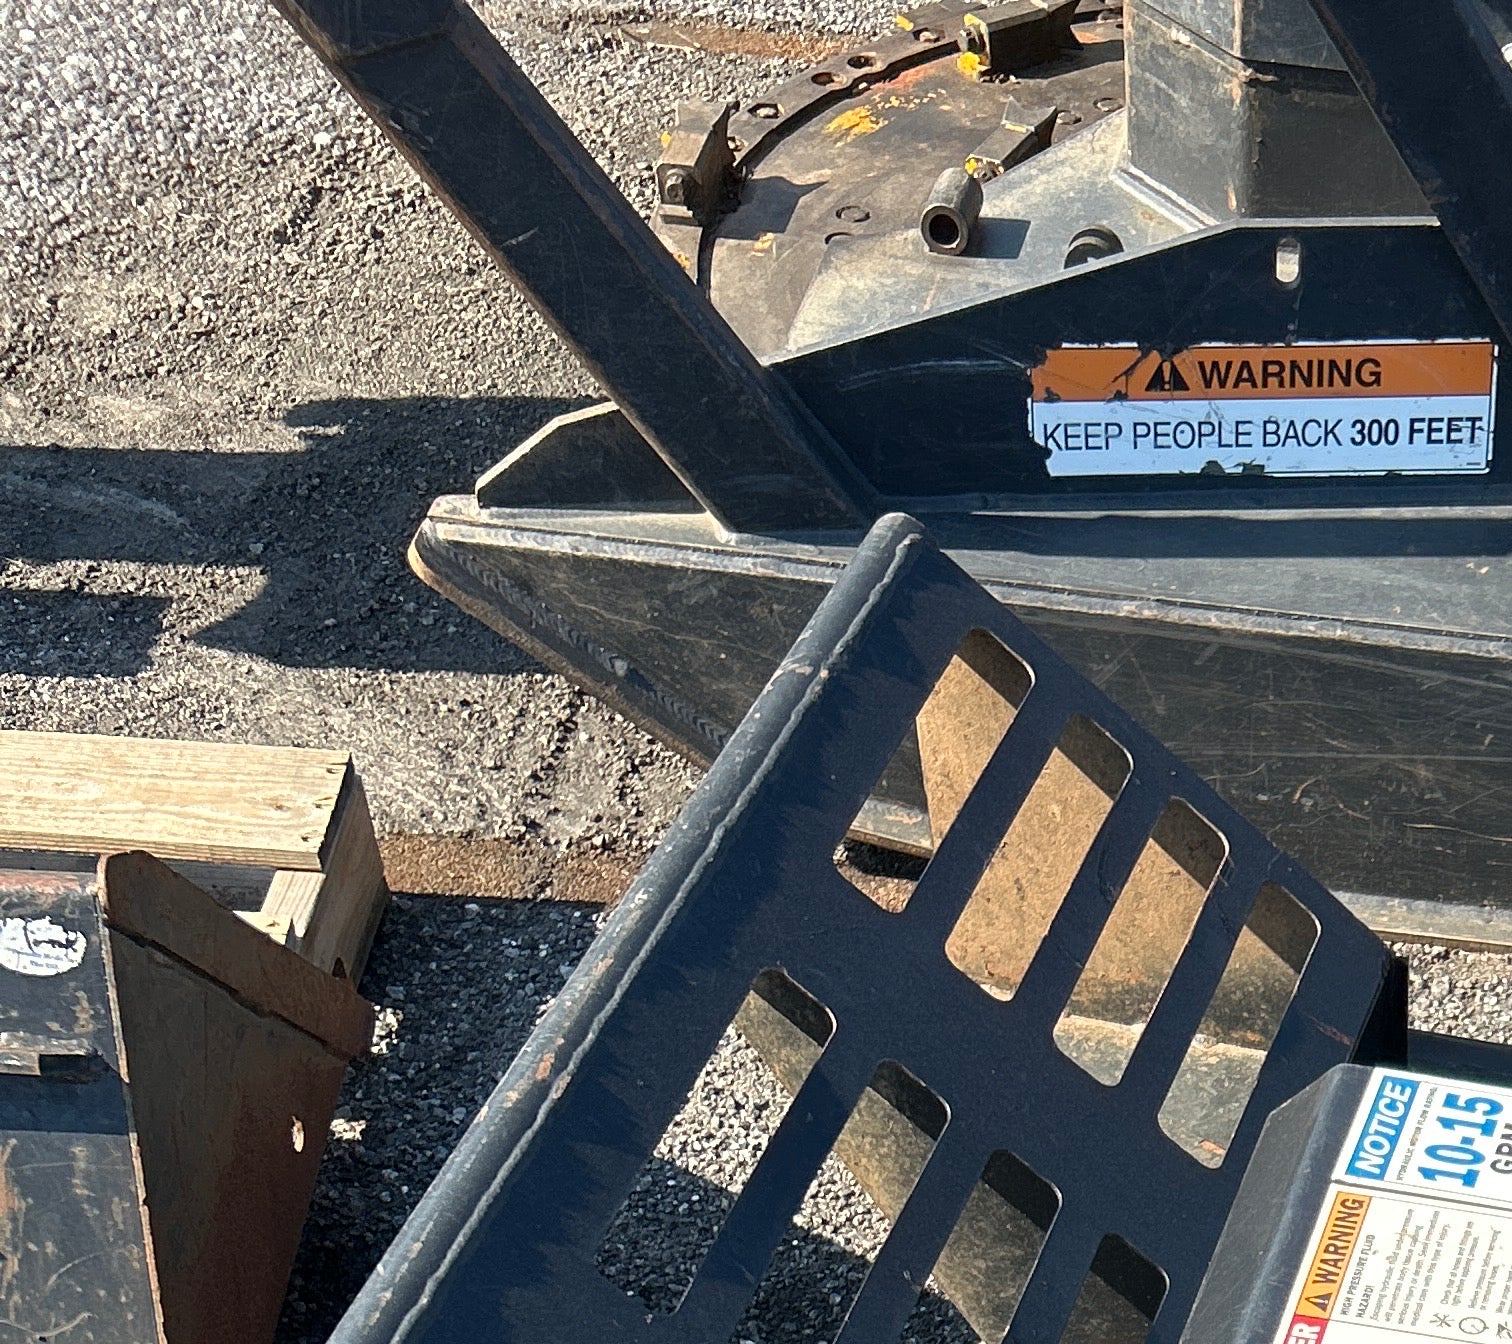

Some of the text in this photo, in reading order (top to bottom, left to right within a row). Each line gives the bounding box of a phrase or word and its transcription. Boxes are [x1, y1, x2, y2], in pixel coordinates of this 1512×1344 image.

[1199, 357, 1383, 390] WARNING
[1043, 416, 1483, 452] KEEP PEOPLE BACK 300 FEET
[1352, 1081, 1413, 1174] NOTICE
[1413, 1091, 1506, 1188] 10-15
[1318, 1197, 1366, 1286] WARNING
[1339, 1234, 1376, 1315] HIGH PRESSURE FLUID
